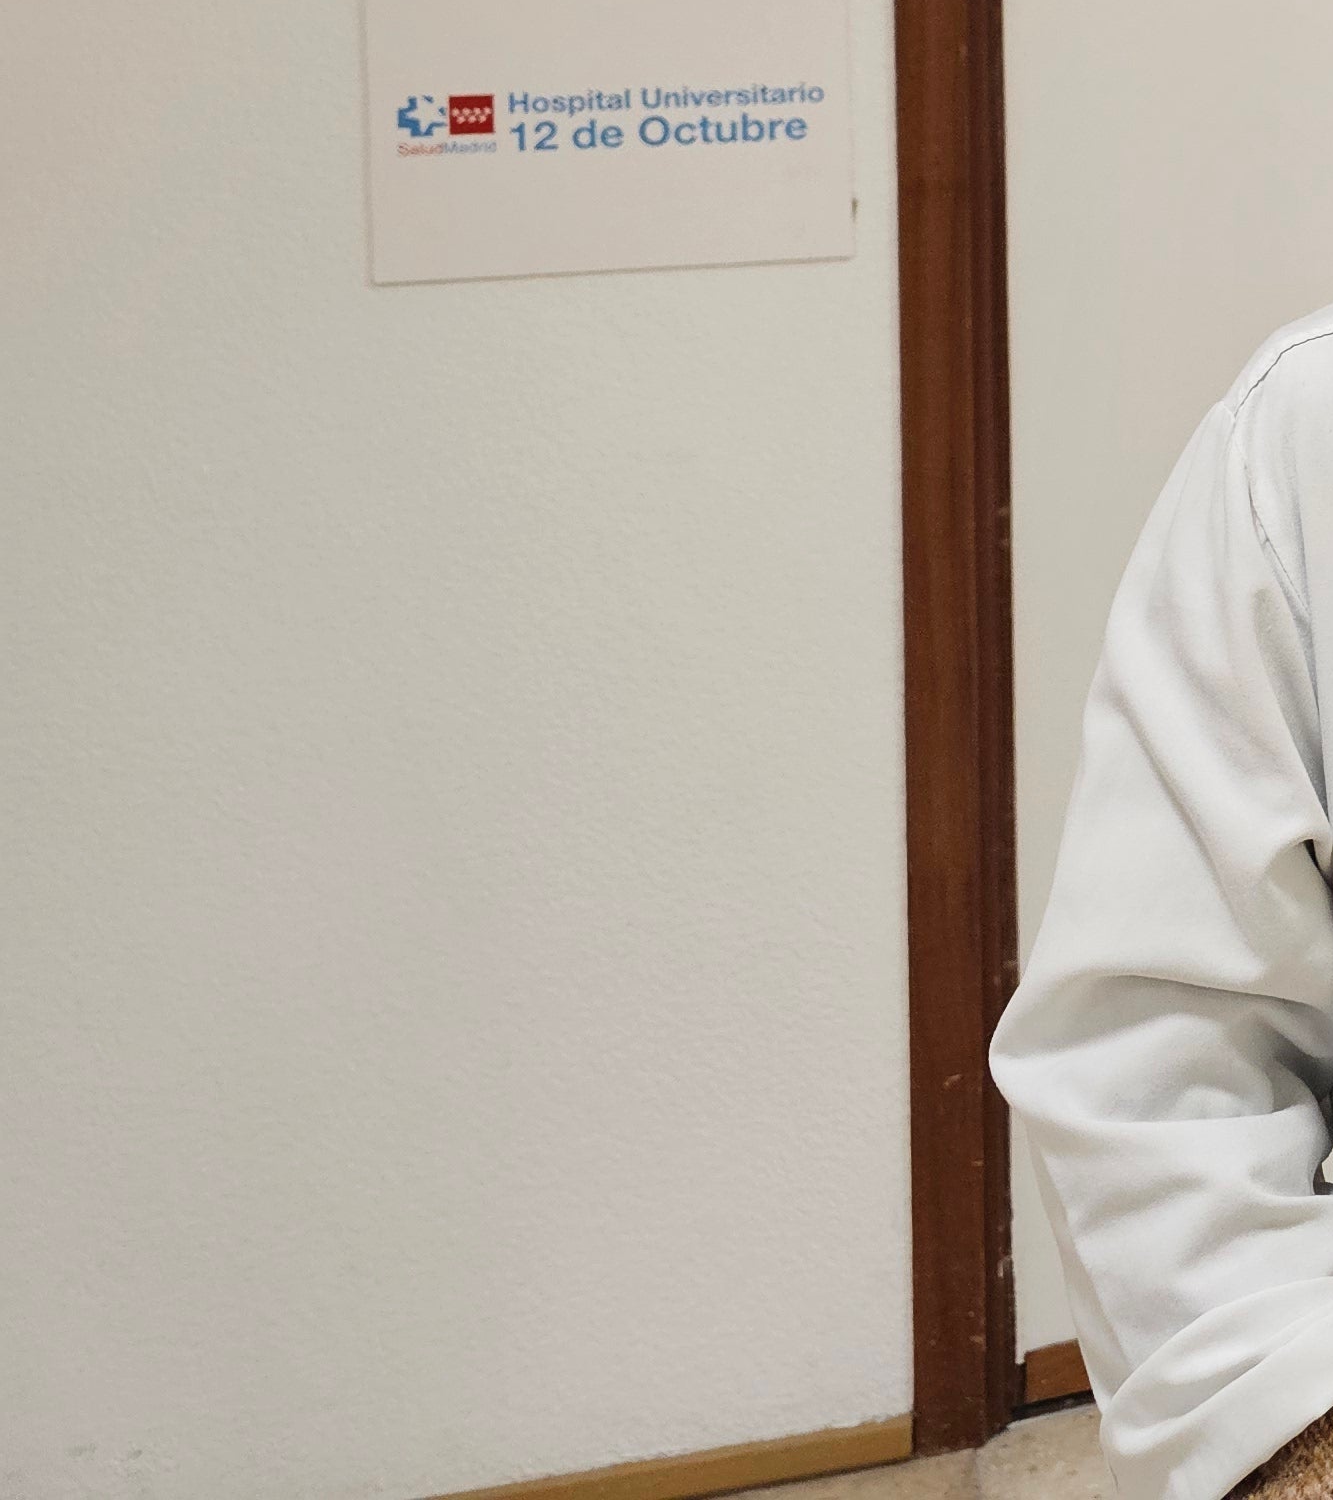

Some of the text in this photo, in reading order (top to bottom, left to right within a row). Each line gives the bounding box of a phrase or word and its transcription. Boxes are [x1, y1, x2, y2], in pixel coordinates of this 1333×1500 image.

[508, 83, 825, 116] Hospital Universitario
[511, 115, 808, 151] 12 de Octubre
